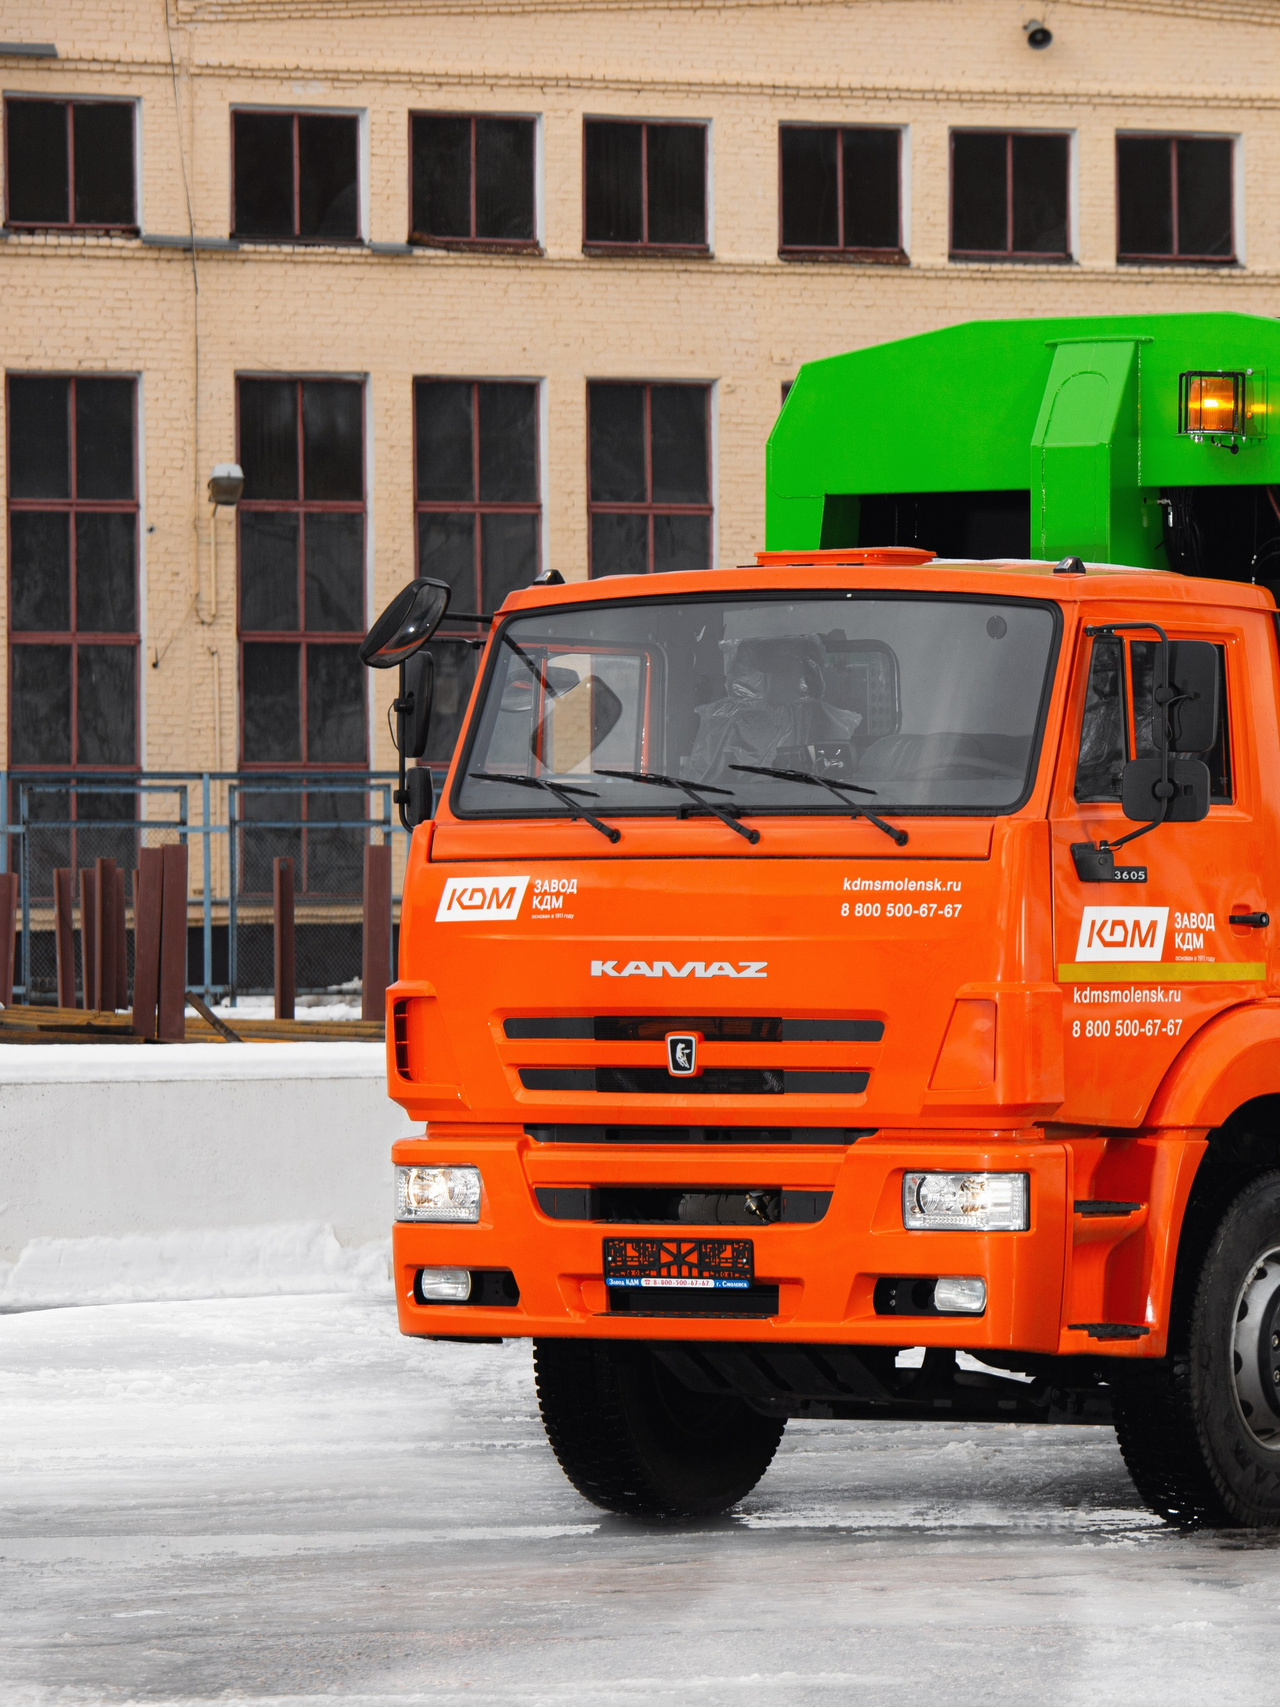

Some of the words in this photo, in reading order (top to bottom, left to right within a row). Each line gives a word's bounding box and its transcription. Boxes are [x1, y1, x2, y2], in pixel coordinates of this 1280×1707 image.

[1113, 871, 1146, 880] 3605
[533, 878, 578, 894] ЗАВОД
[842, 877, 962, 892] kdmsmolensk.ru
[446, 886, 518, 911] KDM
[532, 895, 564, 910] КДМ
[840, 902, 850, 917] 8
[854, 902, 881, 917] 800
[885, 903, 963, 918] 500-67-67
[1174, 911, 1215, 931] ЗАВОД
[1086, 919, 1158, 948] KDM
[1174, 932, 1204, 951] КДМ
[590, 960, 768, 978] KAMAZ
[1073, 986, 1182, 1003] kdmsmolensk.ru
[1072, 1020, 1081, 1038] 8
[1085, 1019, 1111, 1037] 800
[1115, 1019, 1183, 1037] 500-67-67
